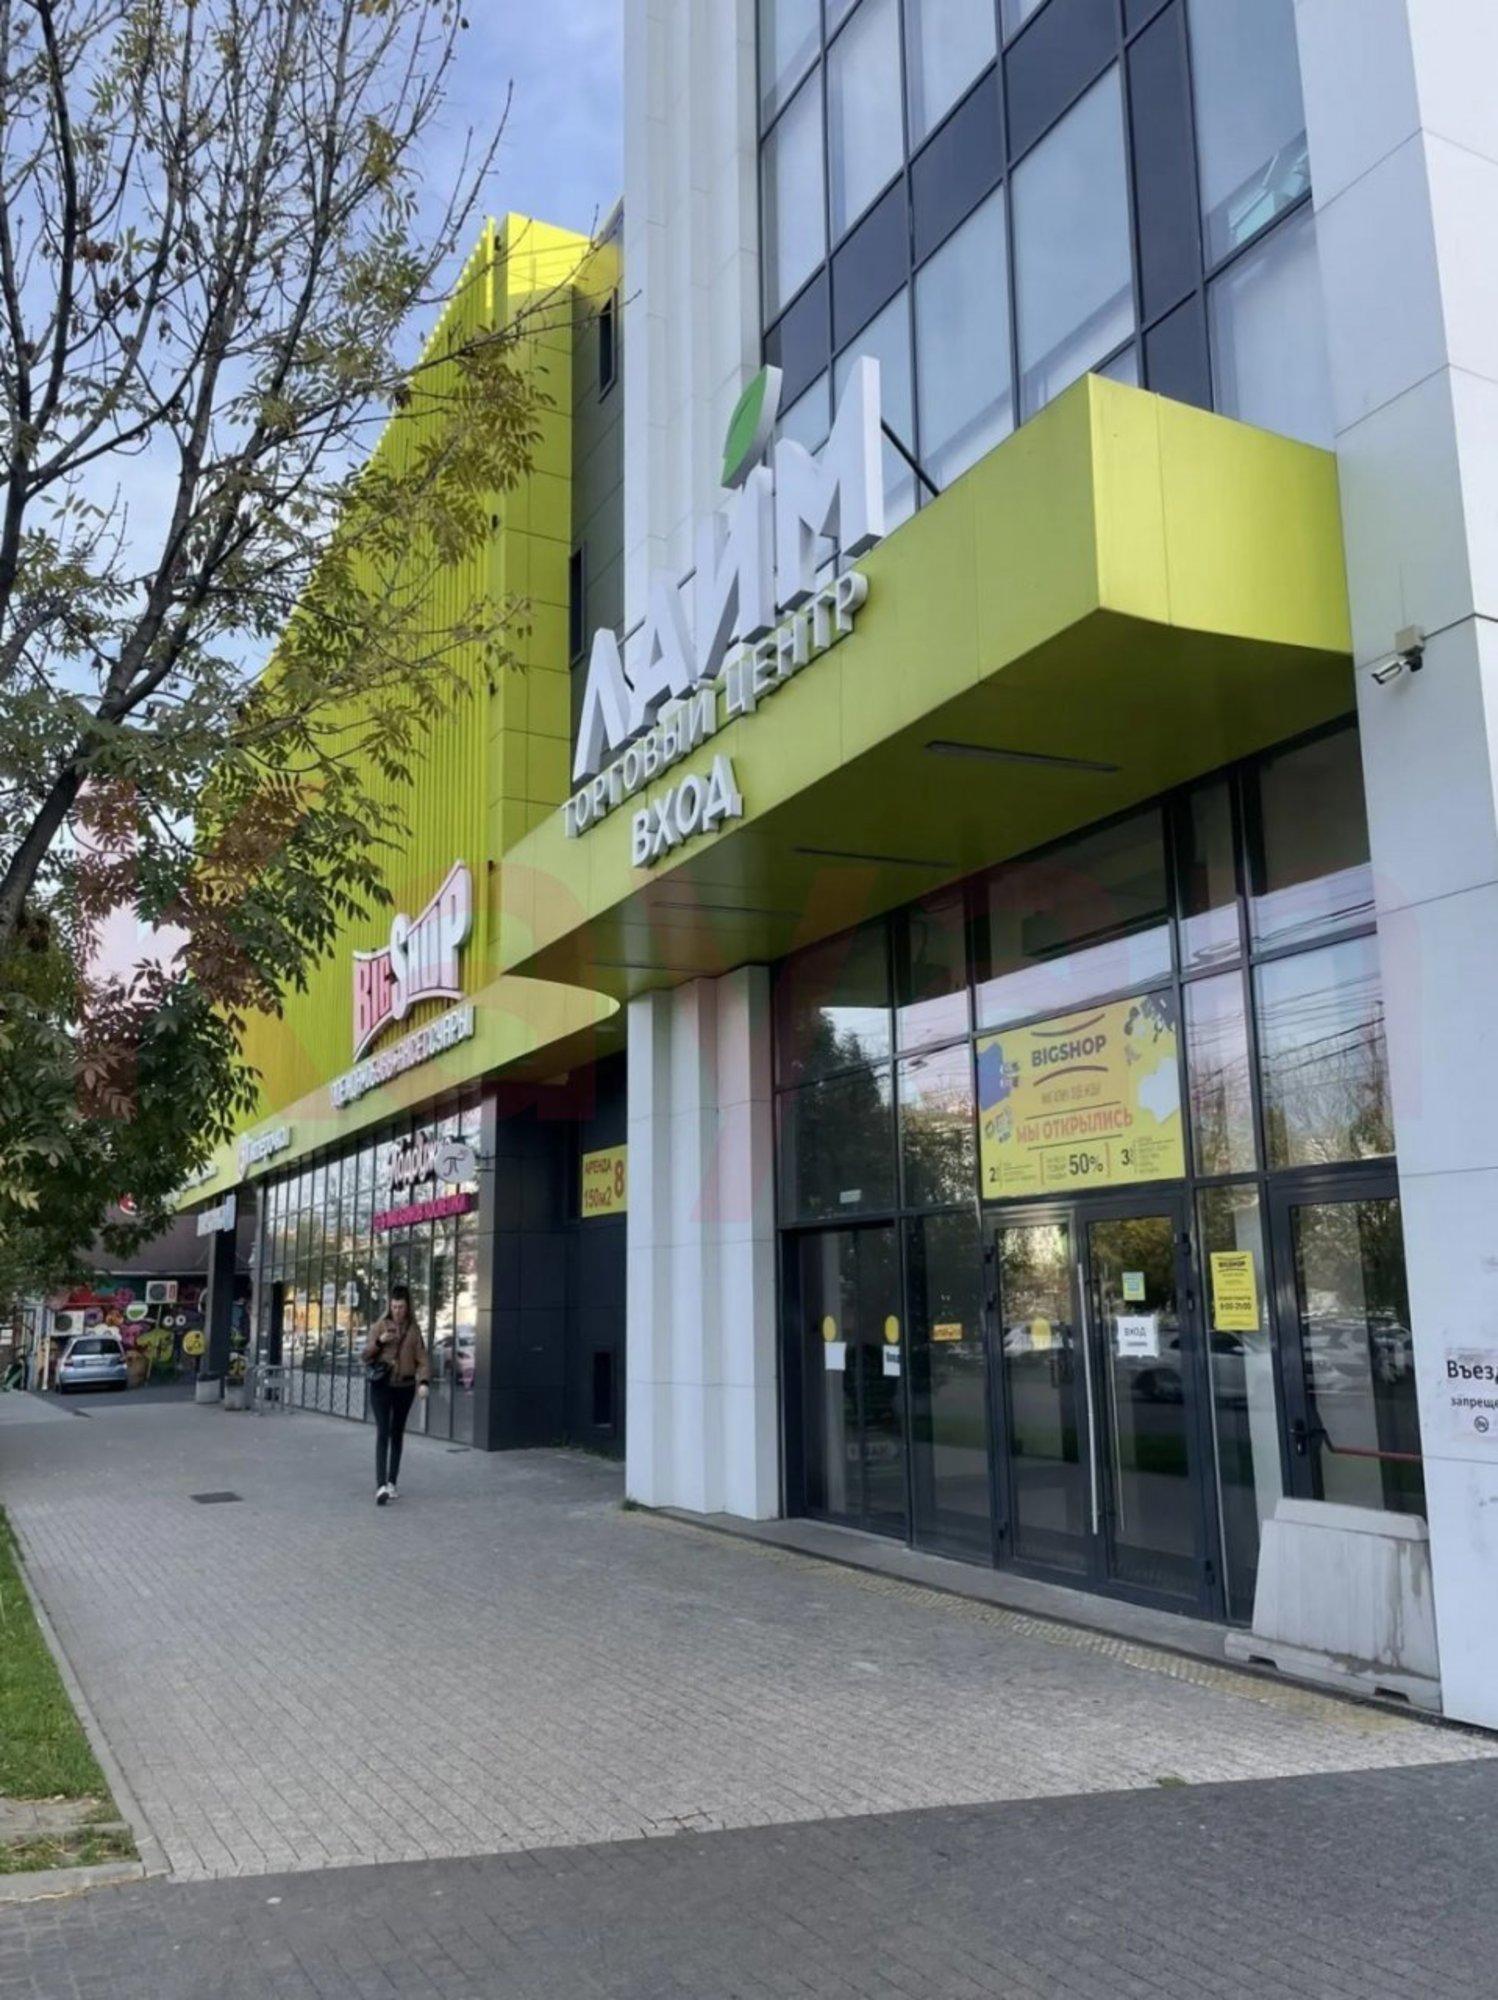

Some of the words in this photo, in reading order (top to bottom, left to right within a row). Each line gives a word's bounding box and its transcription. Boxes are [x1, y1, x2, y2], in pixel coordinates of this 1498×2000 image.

[561, 678, 718, 839] ТОРГОВЫЙ
[725, 570, 869, 716] ЦЕНТР
[631, 754, 743, 868] ВХОД
[1031, 1035, 1106, 1067] BIGSHOP
[1016, 1122, 1040, 1144] МЫ
[1042, 1107, 1133, 1138] ОТКРЫЛИСЬ
[614, 1159, 624, 1199] 8
[989, 1167, 997, 1183] 2
[1069, 1153, 1104, 1176] 50%
